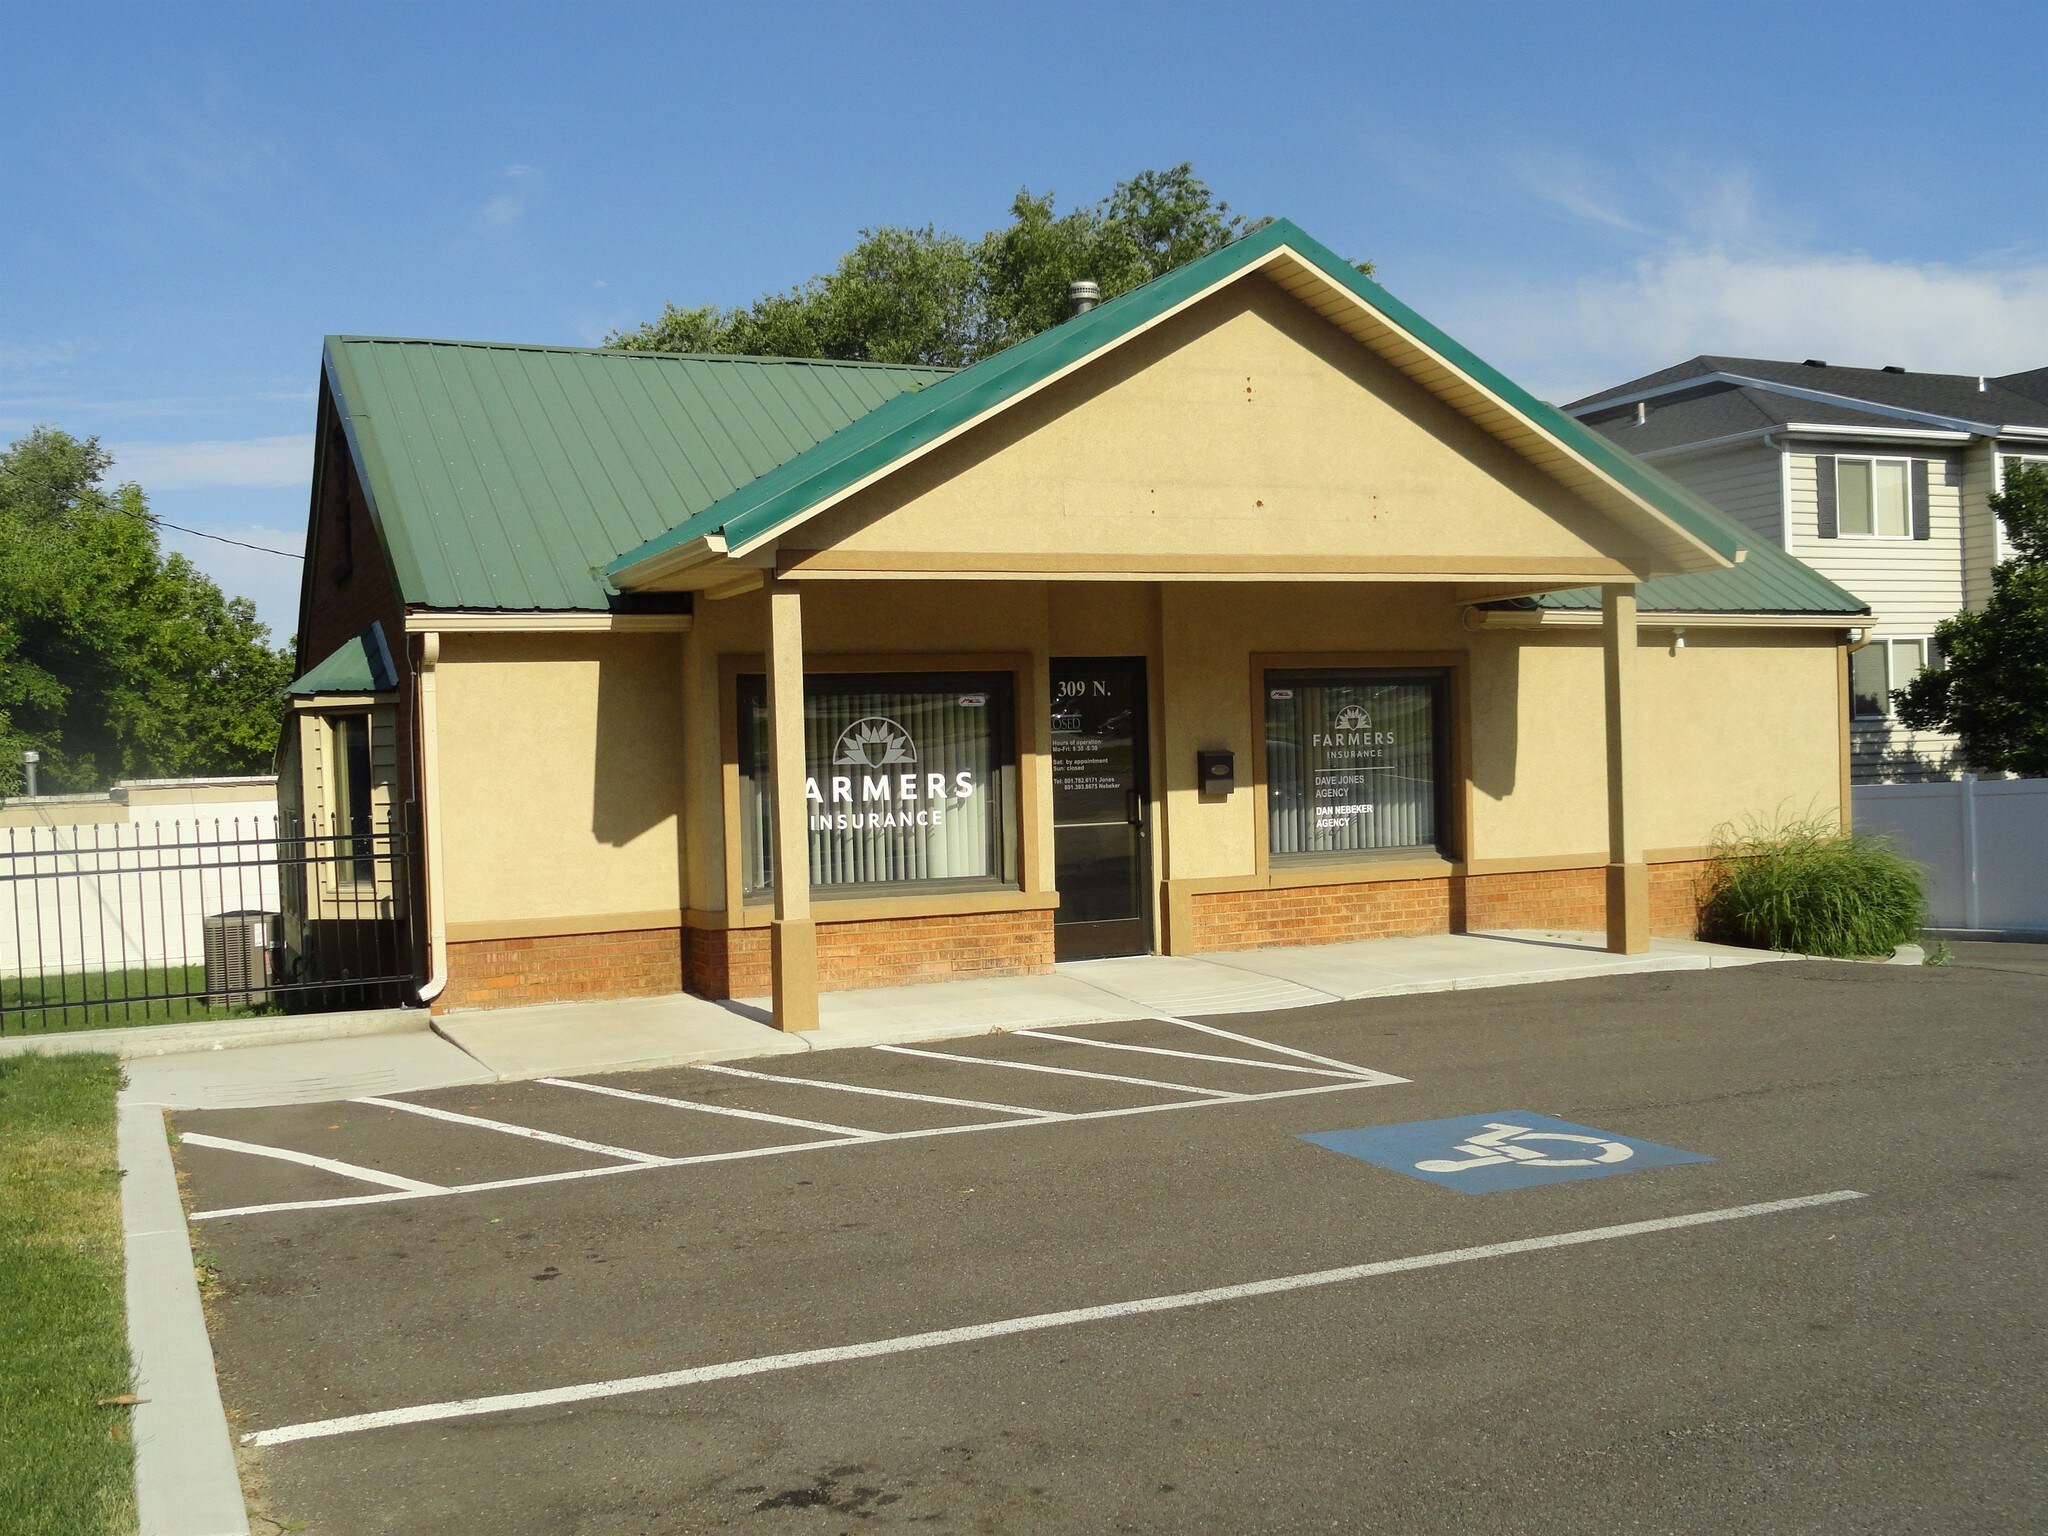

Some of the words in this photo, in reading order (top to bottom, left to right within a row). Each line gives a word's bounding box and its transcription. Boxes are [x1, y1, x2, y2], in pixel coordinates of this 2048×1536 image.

[1057, 680, 1086, 697] 309
[1092, 680, 1111, 697] N.
[1052, 718, 1080, 730] OSED
[1313, 731, 1395, 747] FARMERS
[1326, 749, 1383, 759] INSURANCE
[1315, 776, 1337, 786] DAVE
[1338, 775, 1365, 785] JONES
[805, 772, 974, 803] ARMERS
[1315, 788, 1349, 798] AGENCY
[1316, 805, 1334, 816] DAN
[1335, 804, 1373, 815] NEBEKER
[811, 810, 943, 831] INSURANCE
[1316, 817, 1350, 829] AGENCY
